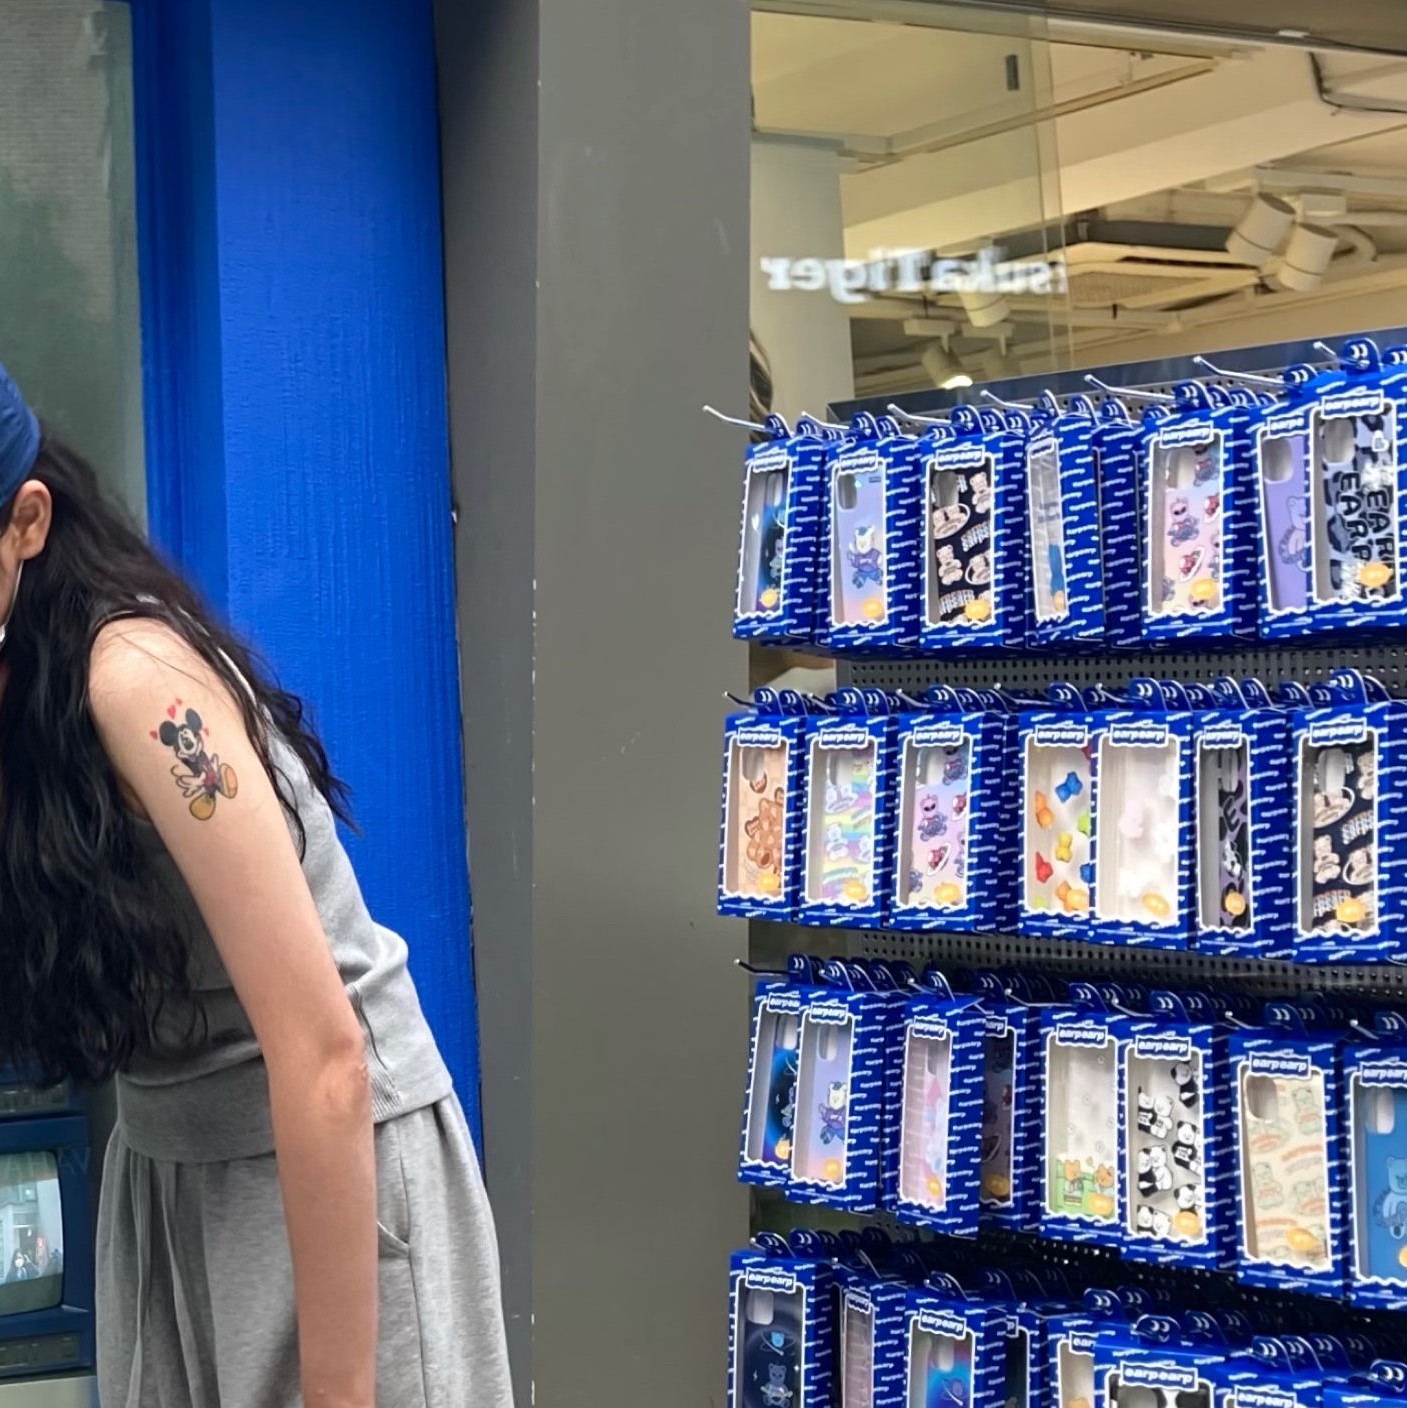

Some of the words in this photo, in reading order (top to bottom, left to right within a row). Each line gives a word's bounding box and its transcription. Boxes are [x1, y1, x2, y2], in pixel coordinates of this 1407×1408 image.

[916, 731, 960, 744] earpearp
[1037, 730, 1084, 743] earpearp
[1113, 729, 1166, 741] earpearp
[1059, 1029, 1105, 1042] earpearp
[1139, 1040, 1187, 1053] earpearp
[1253, 1059, 1307, 1072] earpearp
[748, 1272, 793, 1286] earpearp
[922, 1314, 963, 1332] earpearp
[1124, 1368, 1193, 1384] earpearp
